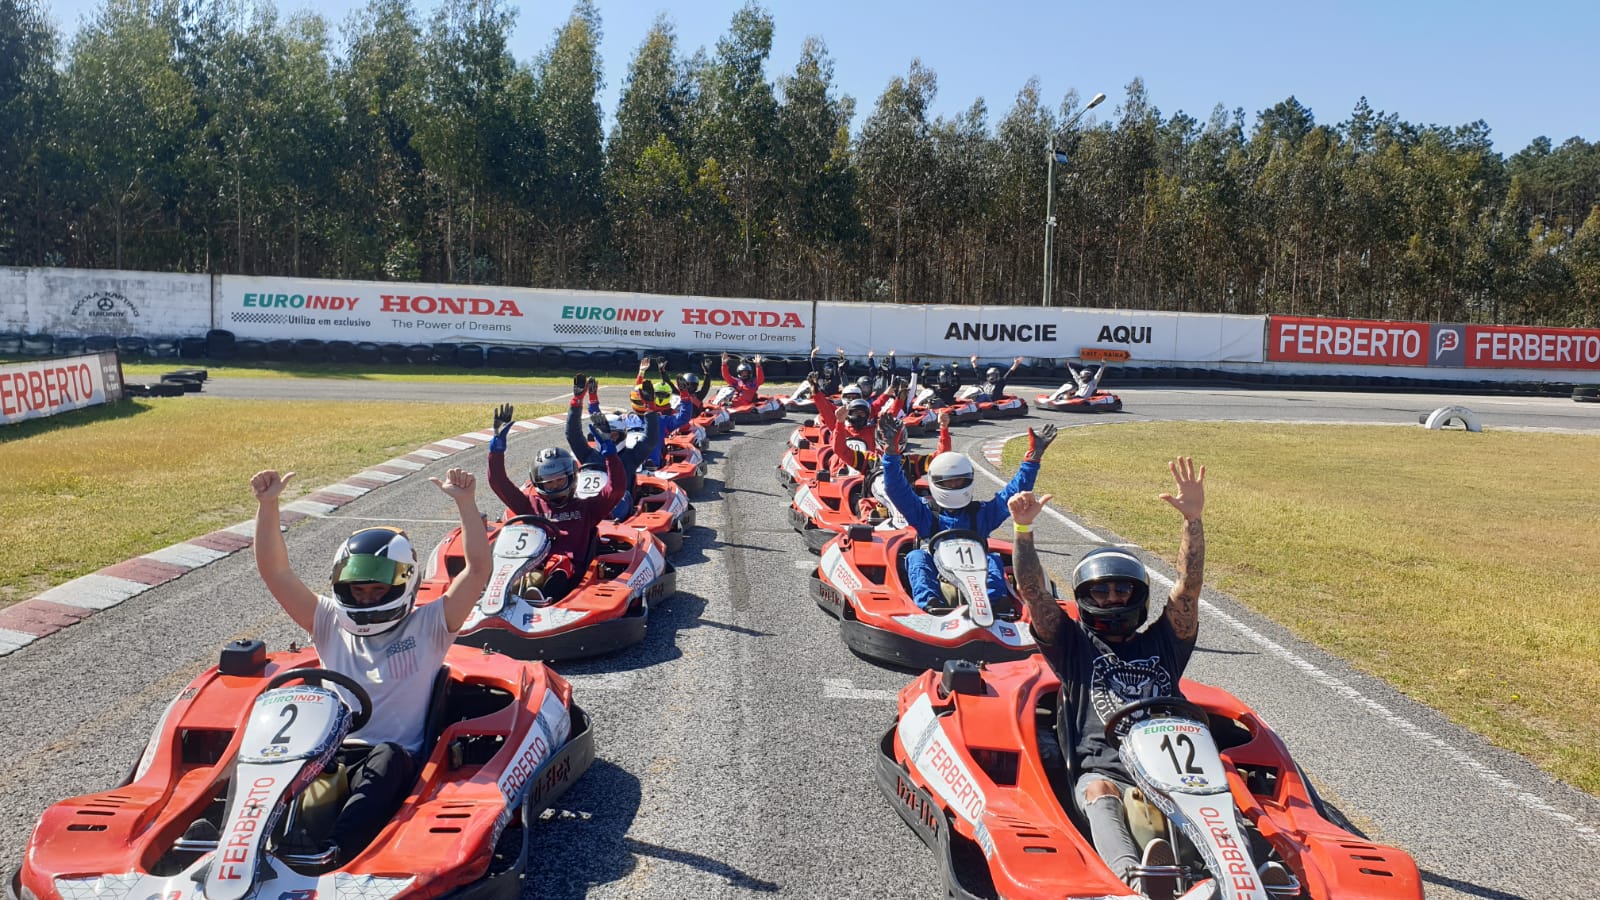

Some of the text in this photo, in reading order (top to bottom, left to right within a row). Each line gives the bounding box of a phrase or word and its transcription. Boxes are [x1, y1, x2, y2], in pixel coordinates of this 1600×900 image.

[243, 293, 361, 311] EUROINDY
[380, 294, 524, 317] HONDA
[333, 316, 371, 327] exclusivo
[561, 305, 664, 322] EUROINDY
[681, 308, 805, 328] HONDA
[392, 319, 512, 332] The Power of Dreams
[643, 329, 676, 338] exclusivo
[944, 322, 1152, 344] ANUNCIE AQUI
[694, 330, 797, 342] The Power of Dreams
[1279, 323, 1421, 358] FERBERTO
[1475, 332, 1600, 363] FERBERTO
[583, 476, 600, 490] 25
[515, 532, 529, 551] 5
[955, 546, 975, 565] 11
[270, 703, 299, 745] 2
[1143, 725, 1202, 735] EUROINDY
[1160, 733, 1205, 775] 12
[500, 736, 548, 803] ERBERTO
[925, 739, 983, 820] FERBERTO
[218, 777, 276, 881] FERBERTO
